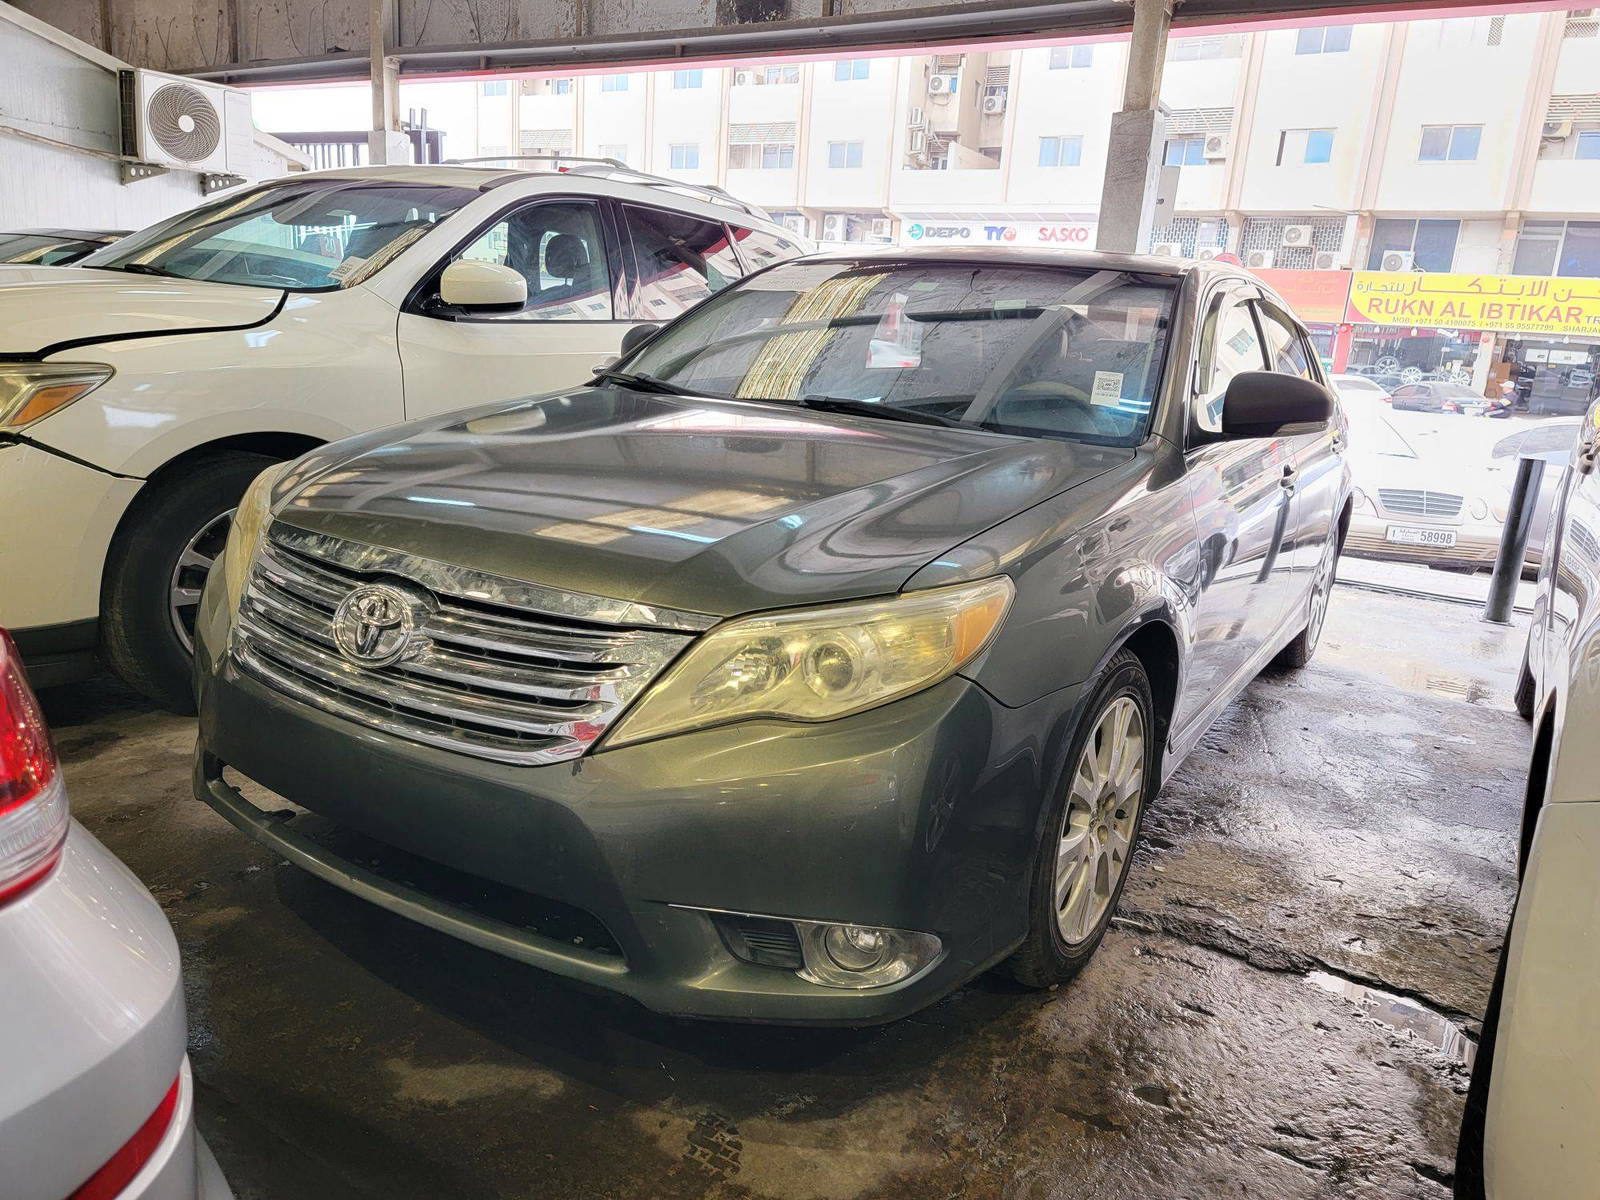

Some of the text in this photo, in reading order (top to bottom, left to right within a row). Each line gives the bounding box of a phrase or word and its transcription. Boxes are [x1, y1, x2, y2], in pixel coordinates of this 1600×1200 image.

[925, 226, 971, 239] DEPO
[1038, 227, 1089, 242] SASCO
[1367, 297, 1434, 317] RUKN
[1440, 300, 1472, 318] AL
[1479, 302, 1584, 324] IBTIKAR
[1562, 325, 1600, 334] SHARJA
[1420, 531, 1453, 544] 58998
